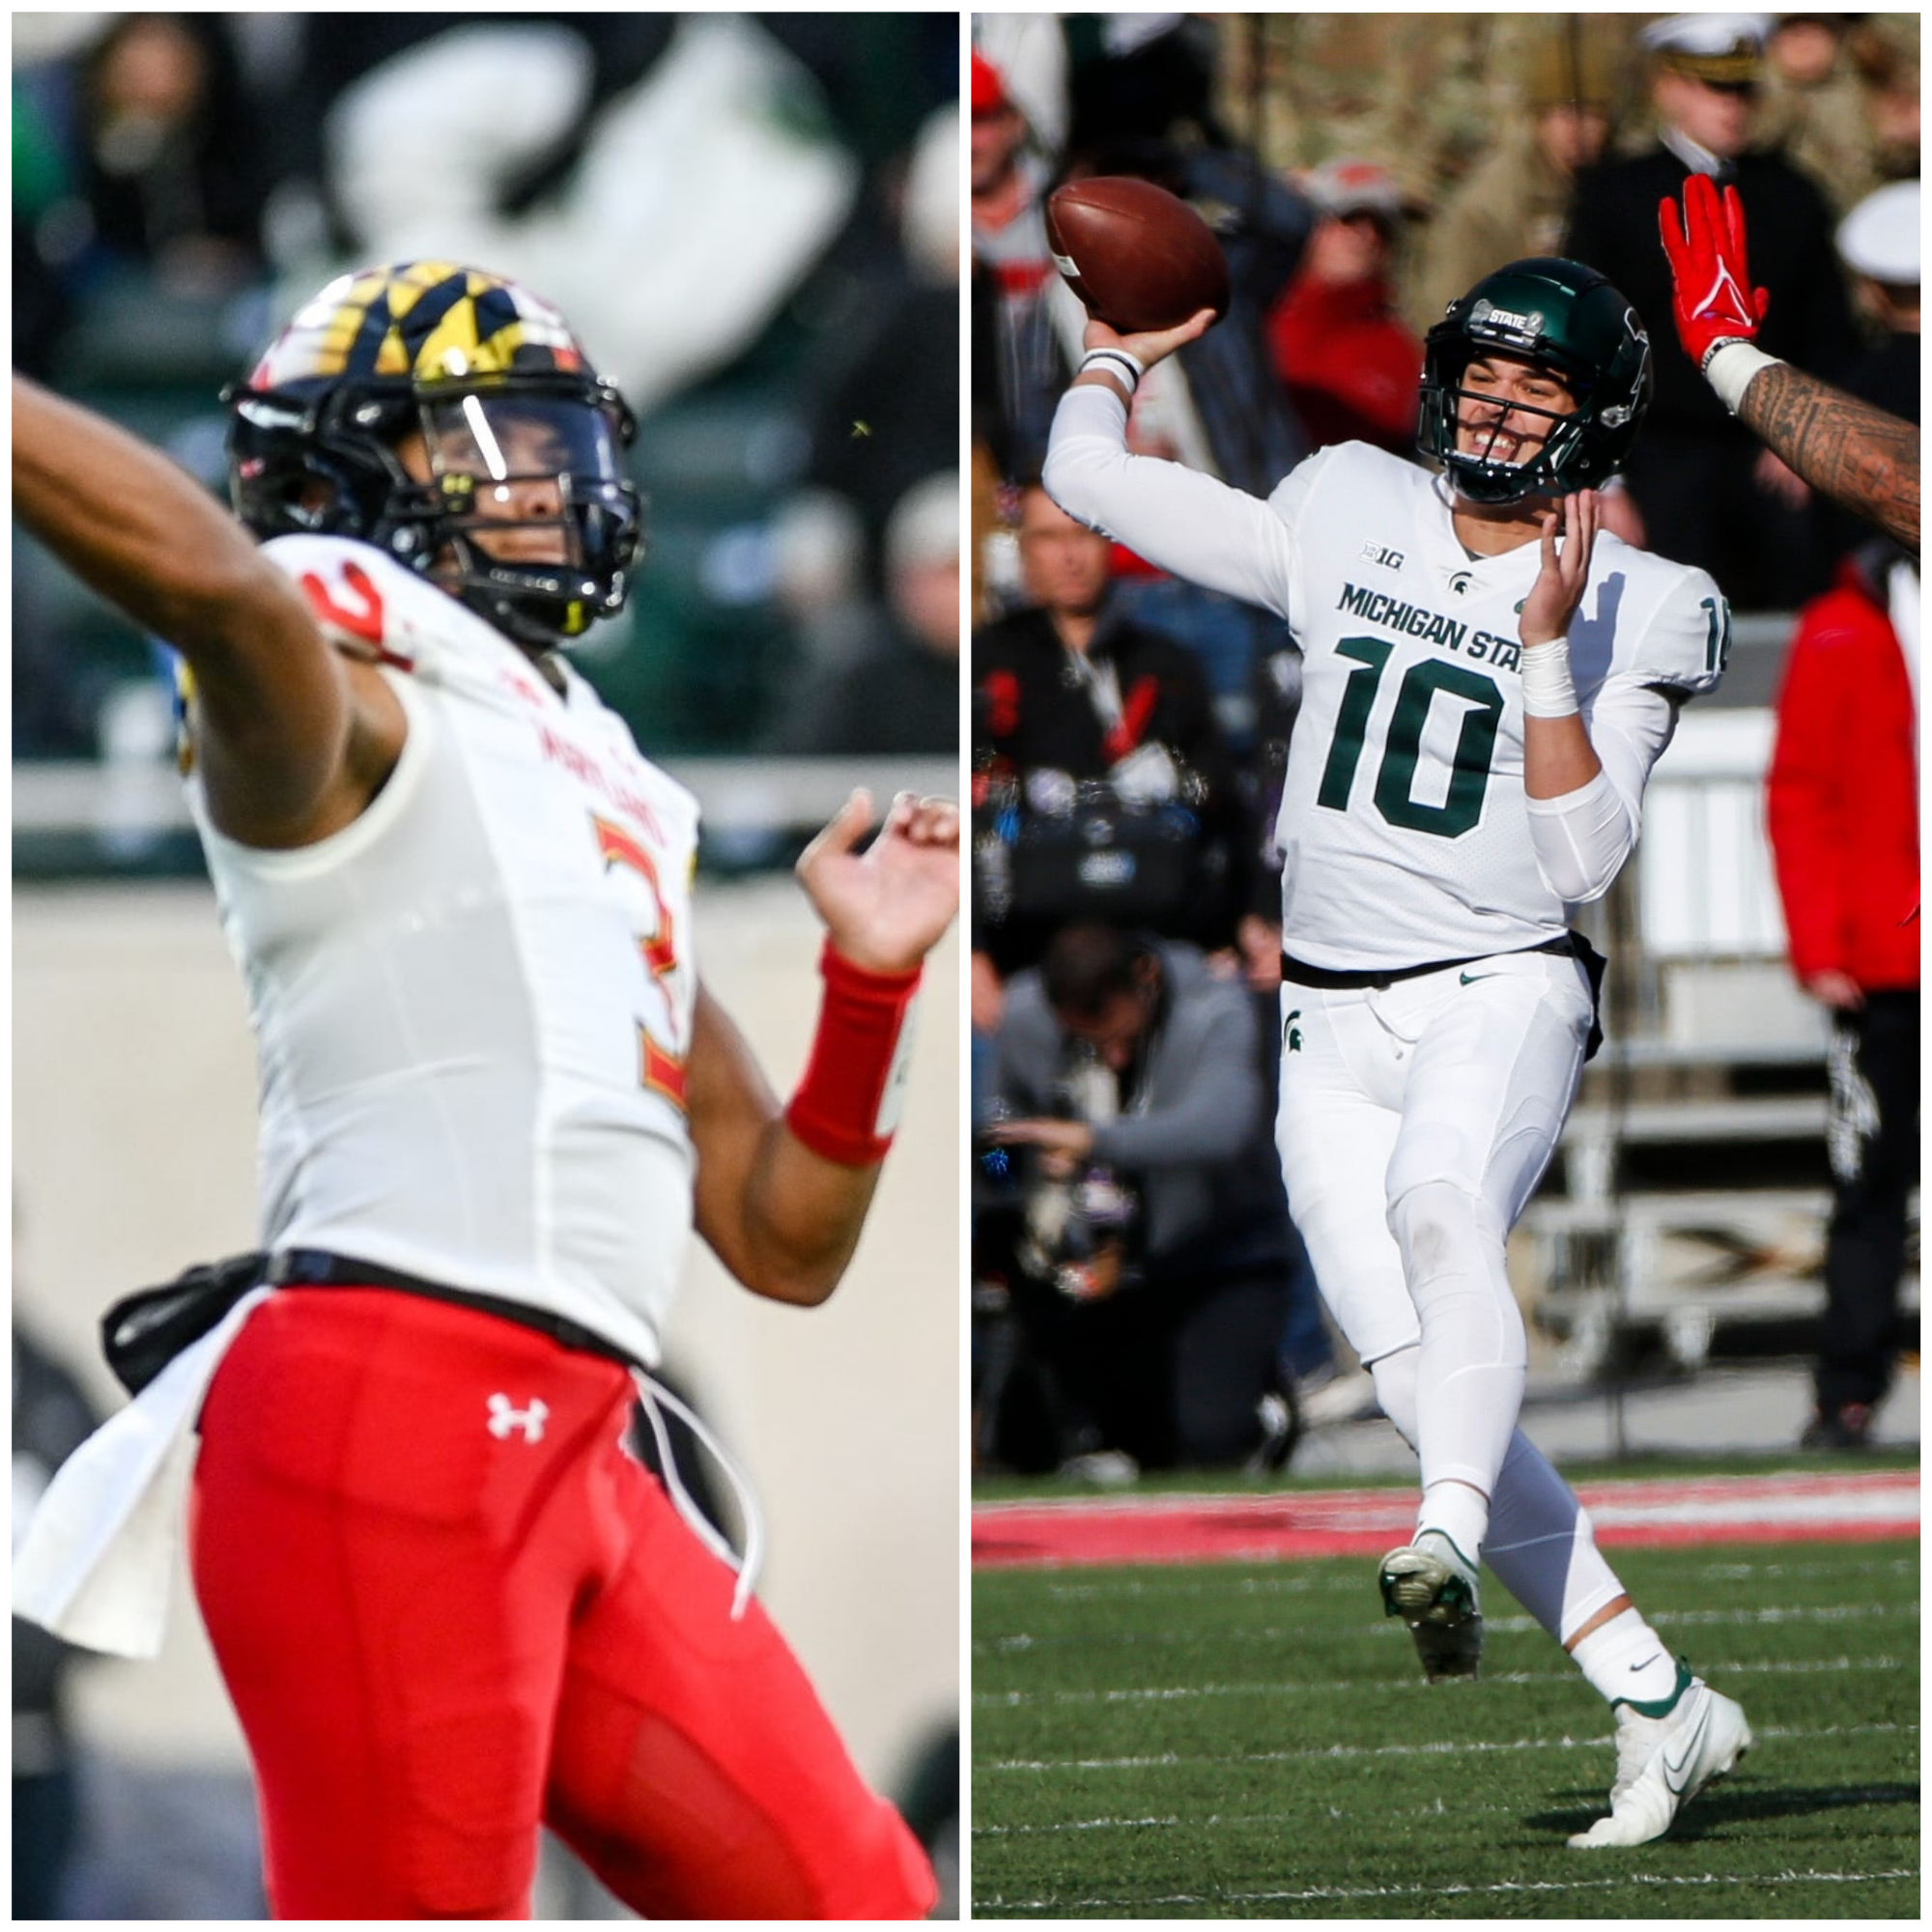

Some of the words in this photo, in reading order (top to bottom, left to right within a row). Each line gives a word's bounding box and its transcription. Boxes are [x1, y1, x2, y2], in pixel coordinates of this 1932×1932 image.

[1489, 308, 1527, 330] STATE
[1336, 582, 1468, 651] MICHIGAN
[1466, 630, 1522, 674] STA
[1316, 635, 1506, 839] 10
